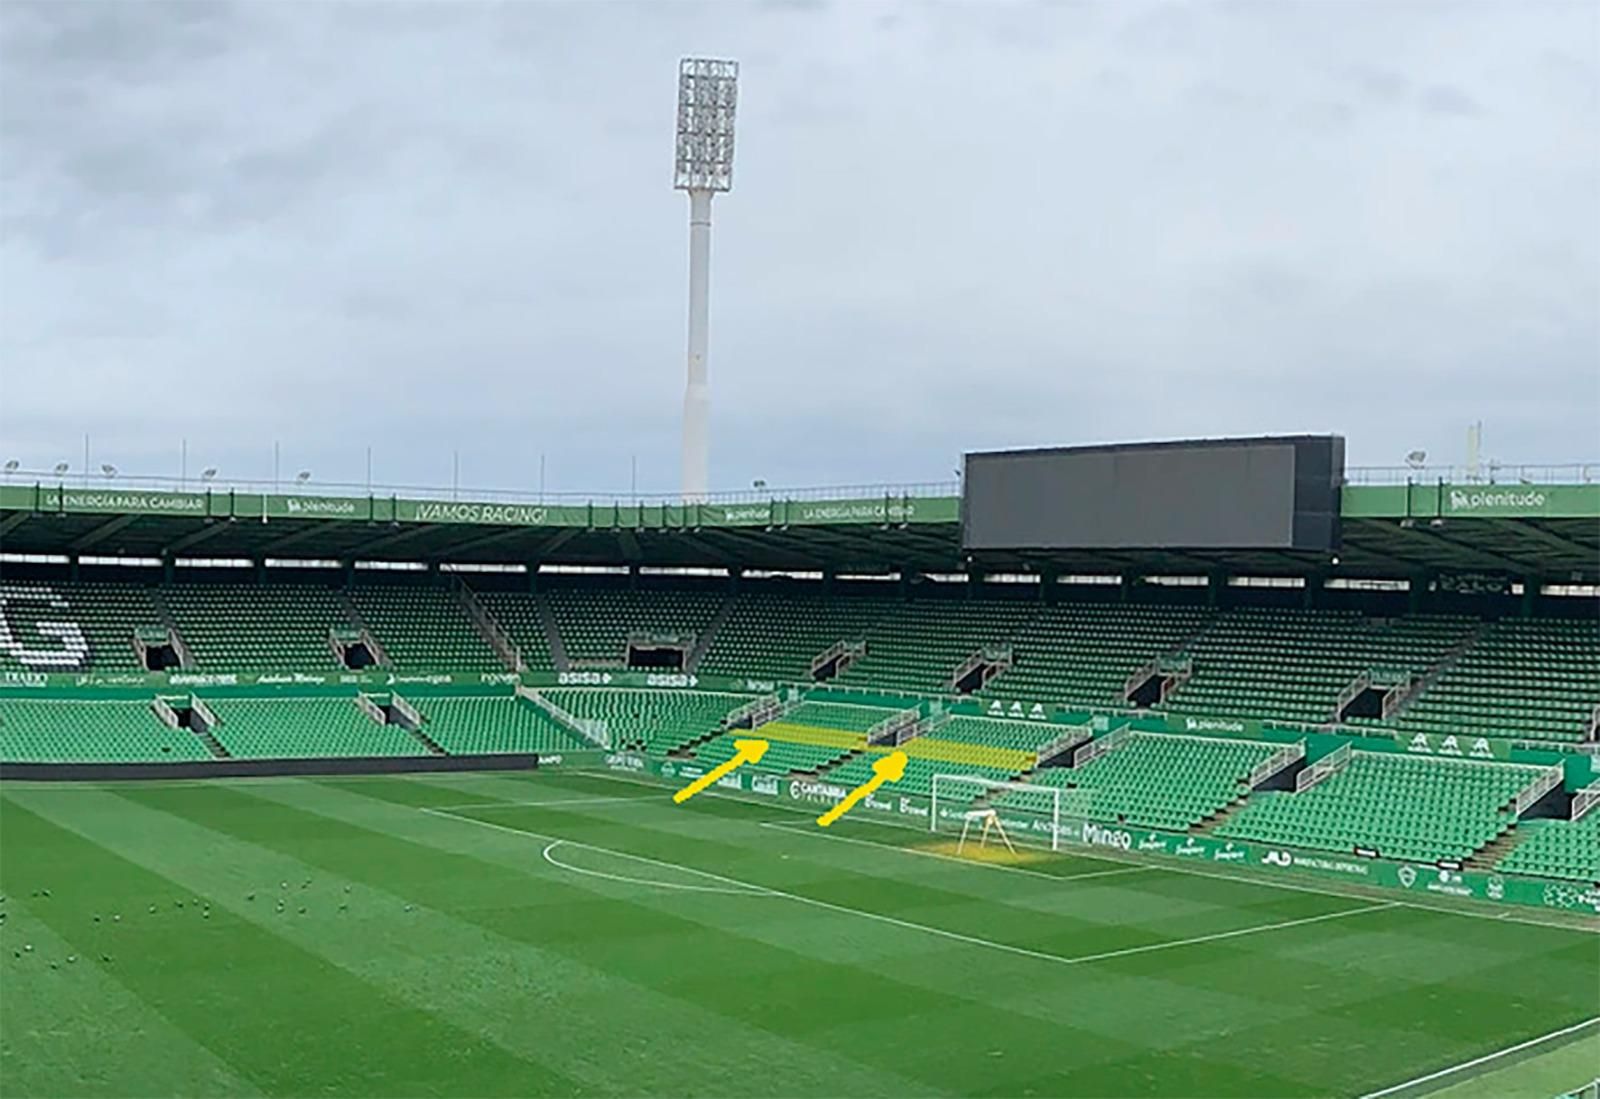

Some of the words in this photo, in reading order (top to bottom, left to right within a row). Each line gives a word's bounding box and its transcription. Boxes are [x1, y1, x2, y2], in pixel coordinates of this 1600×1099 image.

[1471, 491, 1546, 508] plenitude
[558, 672, 601, 685] asisa
[646, 673, 689, 687] asisa
